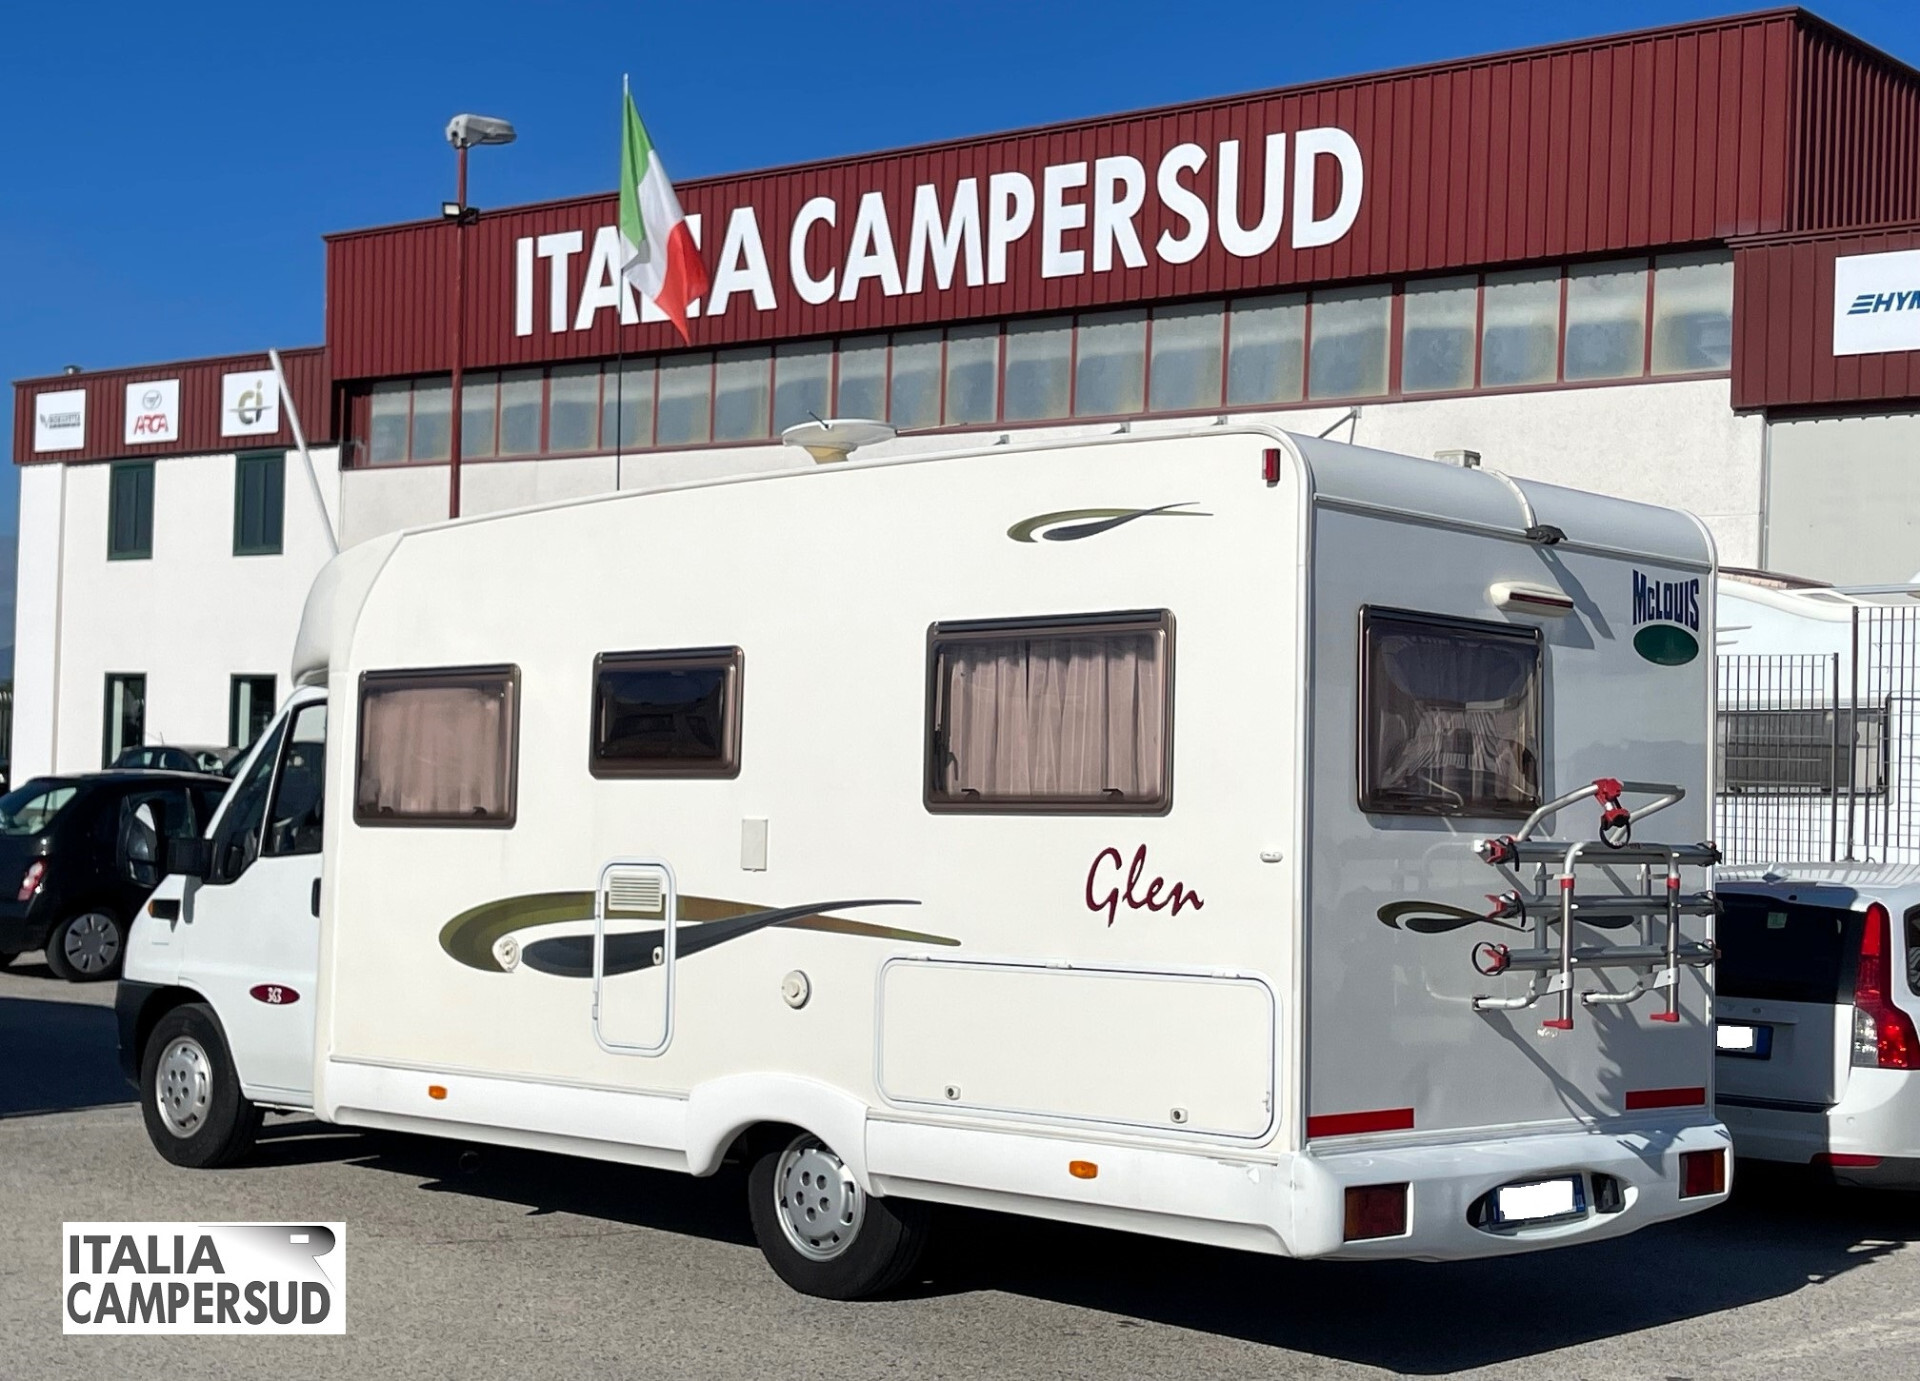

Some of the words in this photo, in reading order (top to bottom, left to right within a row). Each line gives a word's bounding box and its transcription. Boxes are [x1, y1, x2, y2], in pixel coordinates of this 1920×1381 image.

[790, 127, 1364, 305] CAMPERSUD
[134, 413, 169, 435] ARCA
[1085, 843, 1205, 928] Glen
